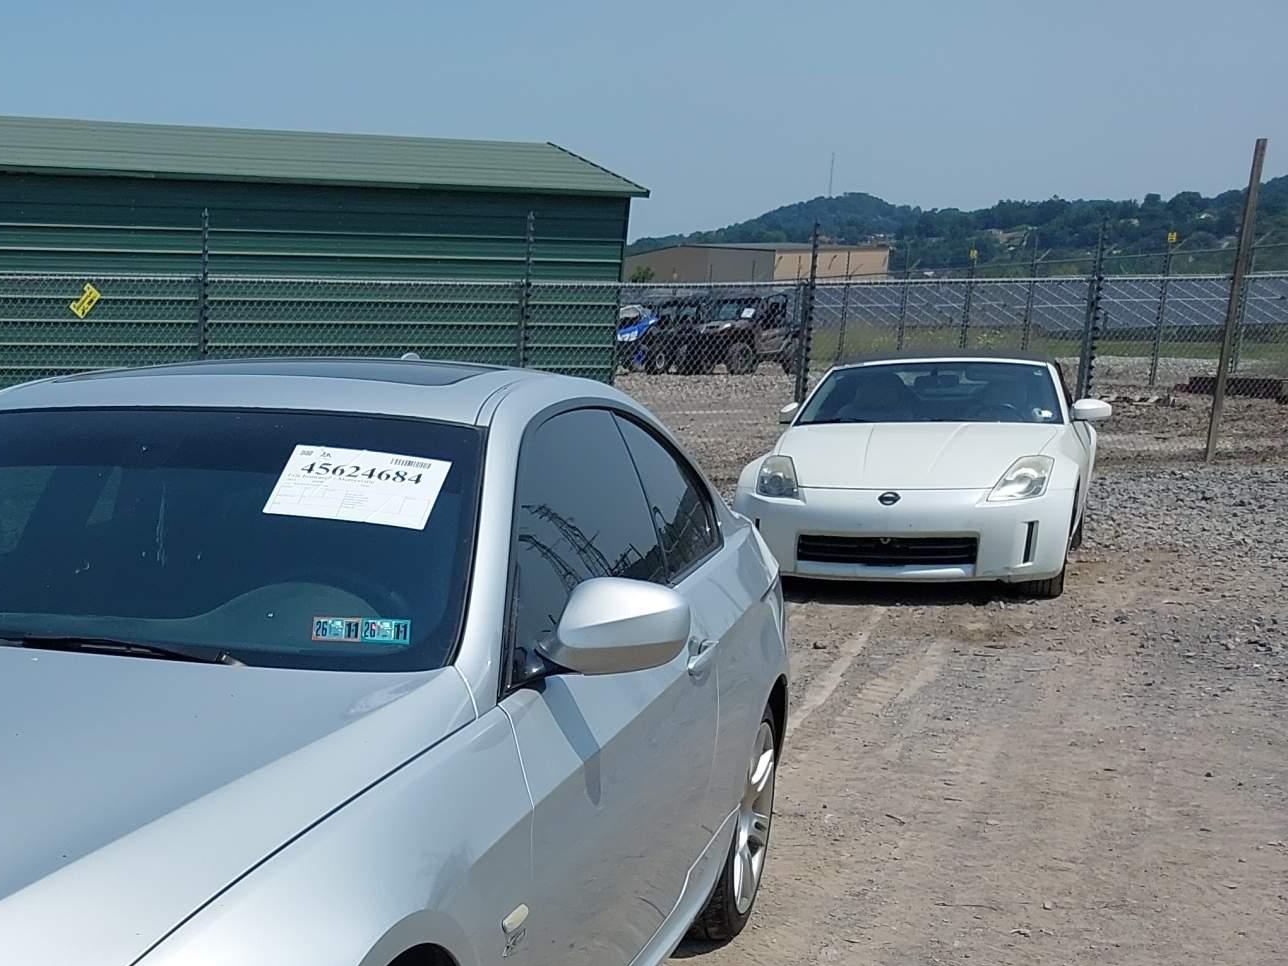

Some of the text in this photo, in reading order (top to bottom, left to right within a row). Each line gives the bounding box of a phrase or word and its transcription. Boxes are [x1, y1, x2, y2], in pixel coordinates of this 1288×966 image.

[300, 462, 423, 485] 45624684
[315, 620, 328, 637] 26
[363, 621, 376, 638] 26
